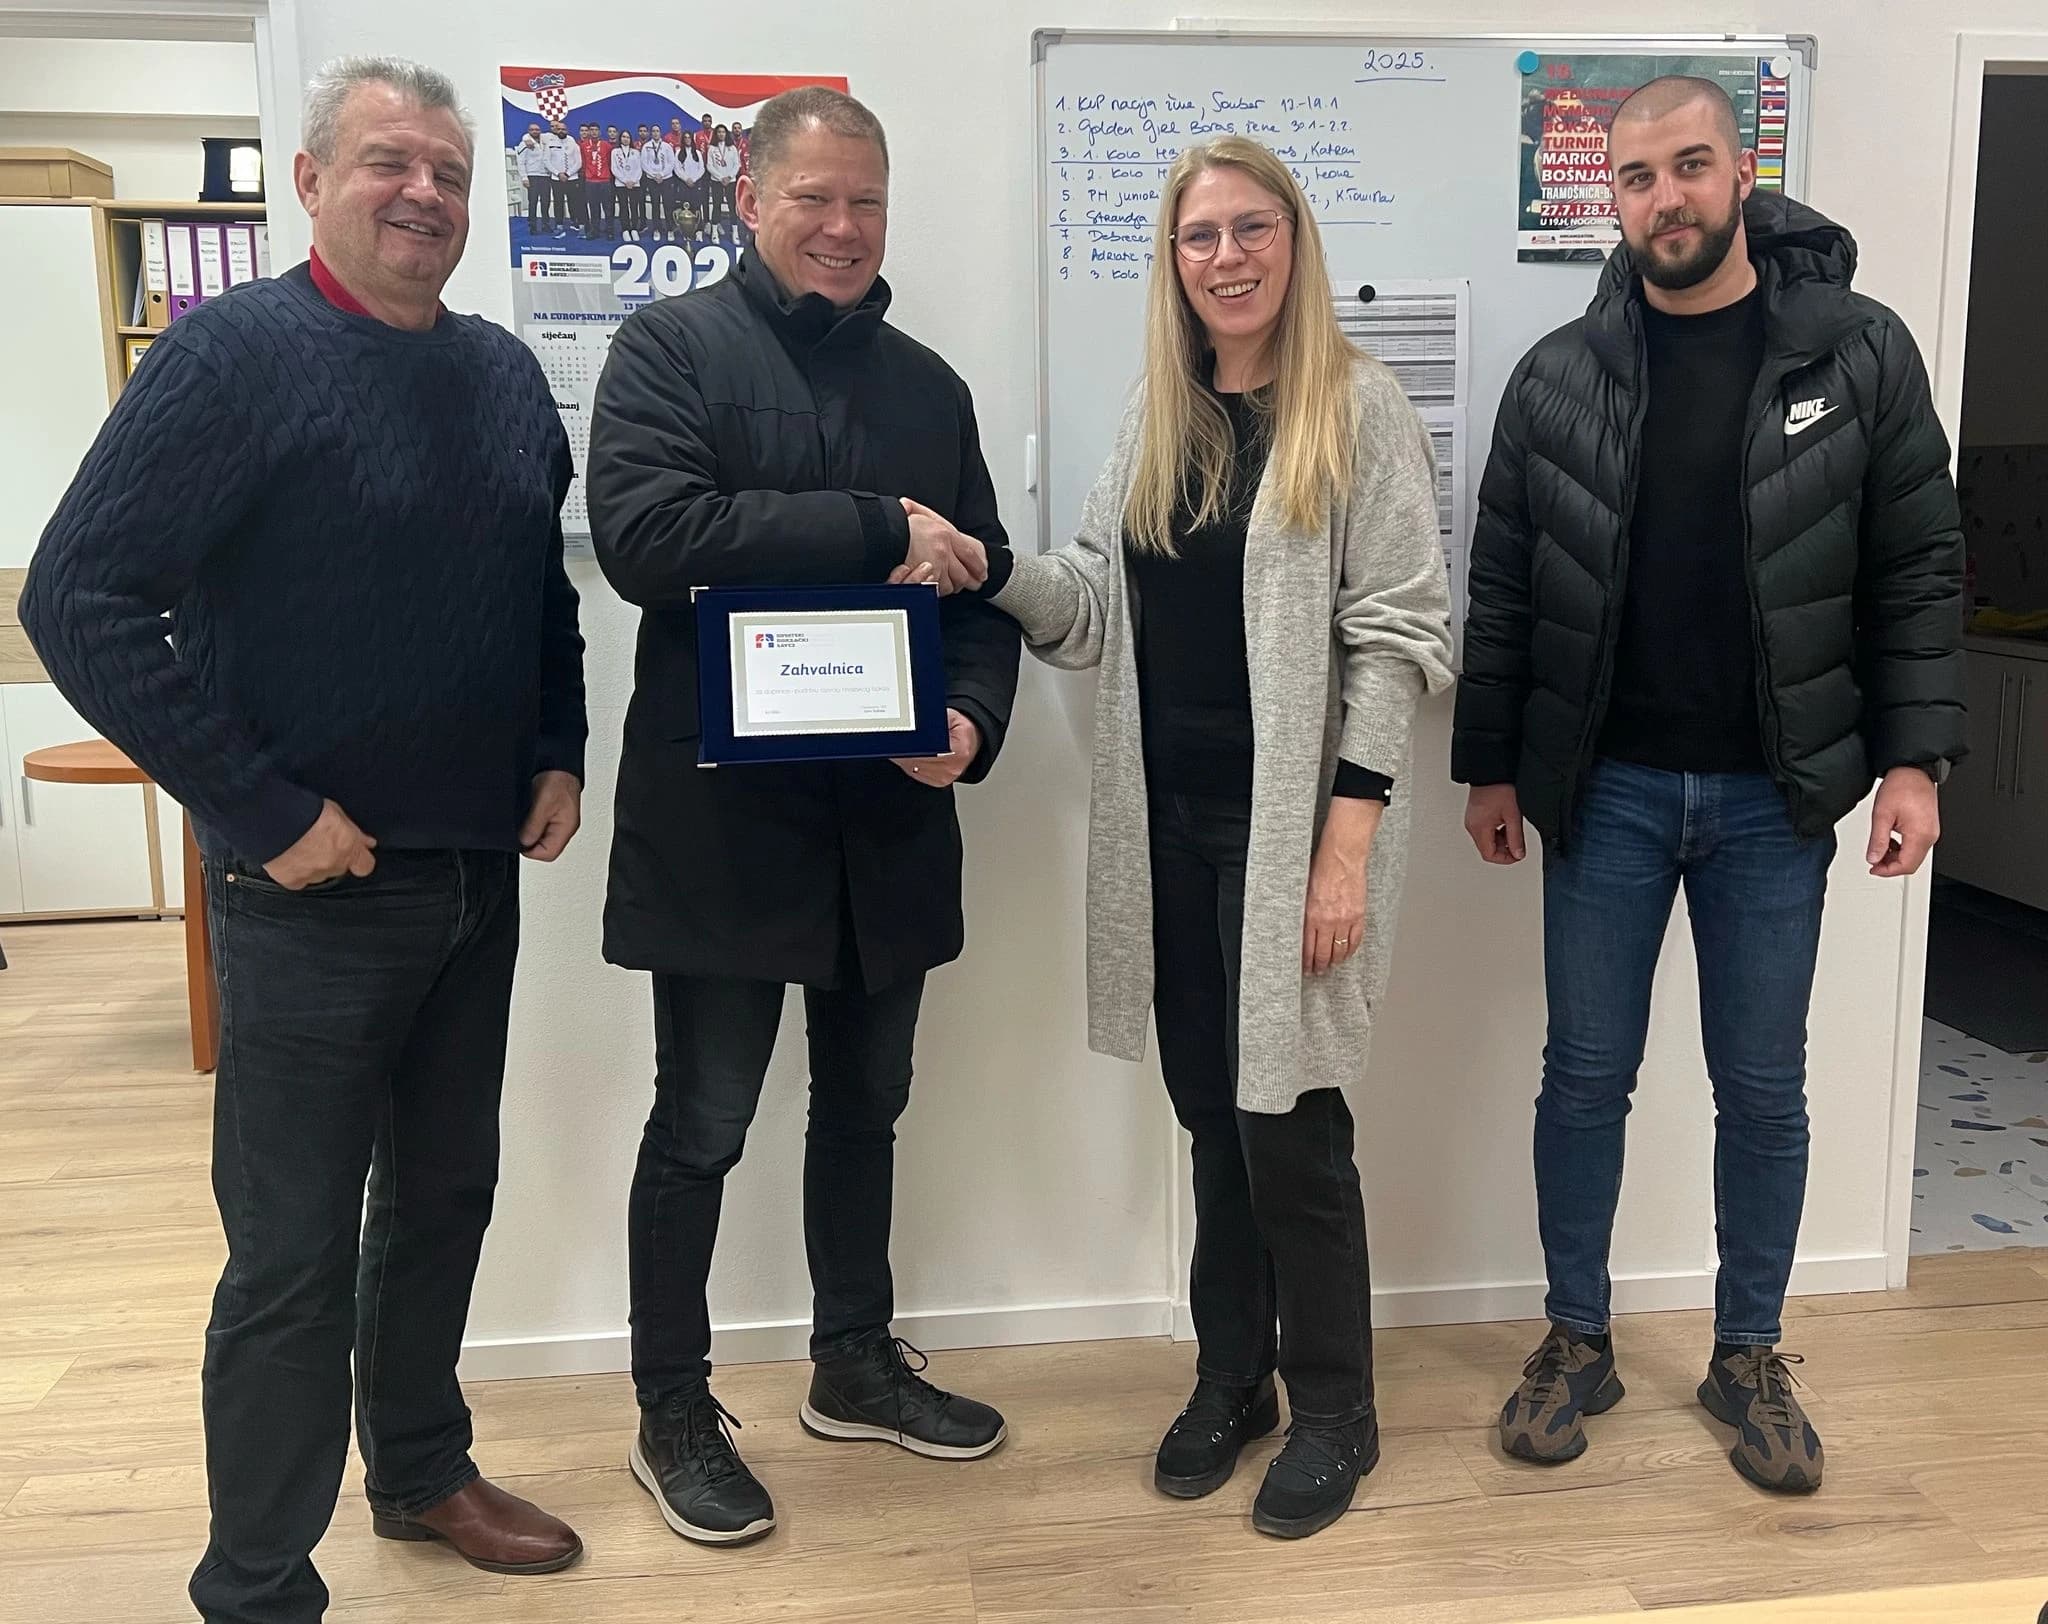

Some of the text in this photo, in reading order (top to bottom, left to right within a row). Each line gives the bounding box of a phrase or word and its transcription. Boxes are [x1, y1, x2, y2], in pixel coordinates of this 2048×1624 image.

[1363, 49, 1435, 72] 2025.
[1542, 136, 1605, 149] TURNIR
[1059, 147, 1076, 159] 3.
[1541, 152, 1606, 166] MARKO
[1060, 167, 1076, 181] 4.
[1088, 189, 1108, 202] PH
[1541, 184, 1614, 200] TRAMOŠNICA-B
[1541, 204, 1574, 217] 27.7.
[1576, 204, 1581, 216] i
[1540, 217, 1548, 226] U
[1570, 217, 1620, 226] NOGOMETN
[612, 244, 745, 297] 202
[533, 312, 548, 320] NA
[550, 313, 607, 321] EUROPSKIM
[541, 331, 577, 341] siječanj
[1789, 397, 1826, 422] NIKE
[780, 662, 864, 676] Zahvalnica
